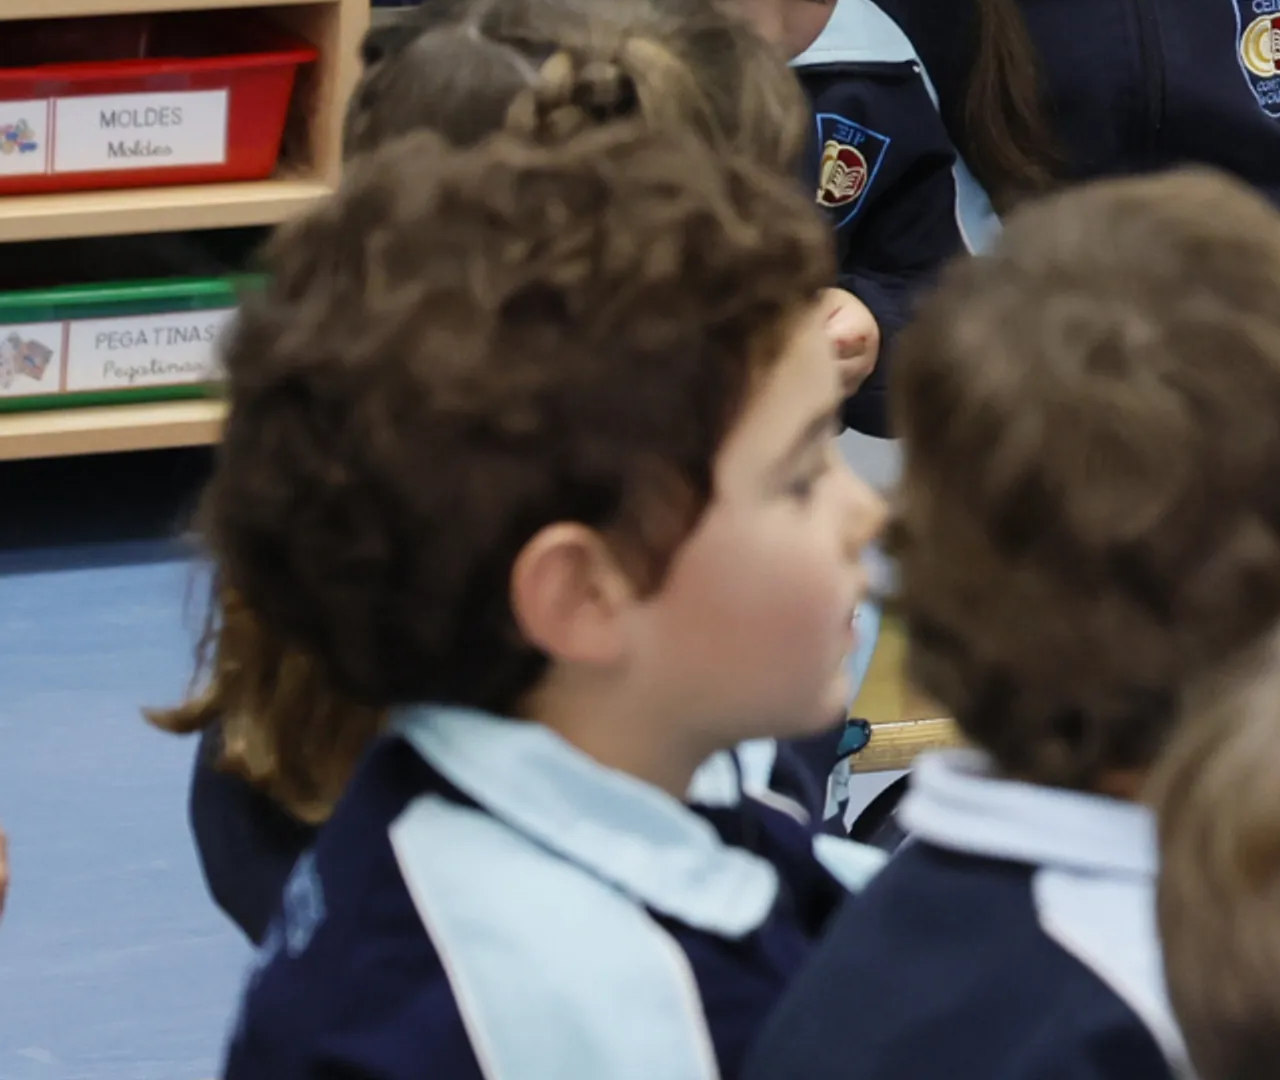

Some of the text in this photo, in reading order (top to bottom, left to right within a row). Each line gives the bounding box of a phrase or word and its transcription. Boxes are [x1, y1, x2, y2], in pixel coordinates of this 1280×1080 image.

[100, 106, 183, 129] MOLDES
[107, 141, 173, 159] Moldes
[95, 324, 216, 350] PEGATINAS
